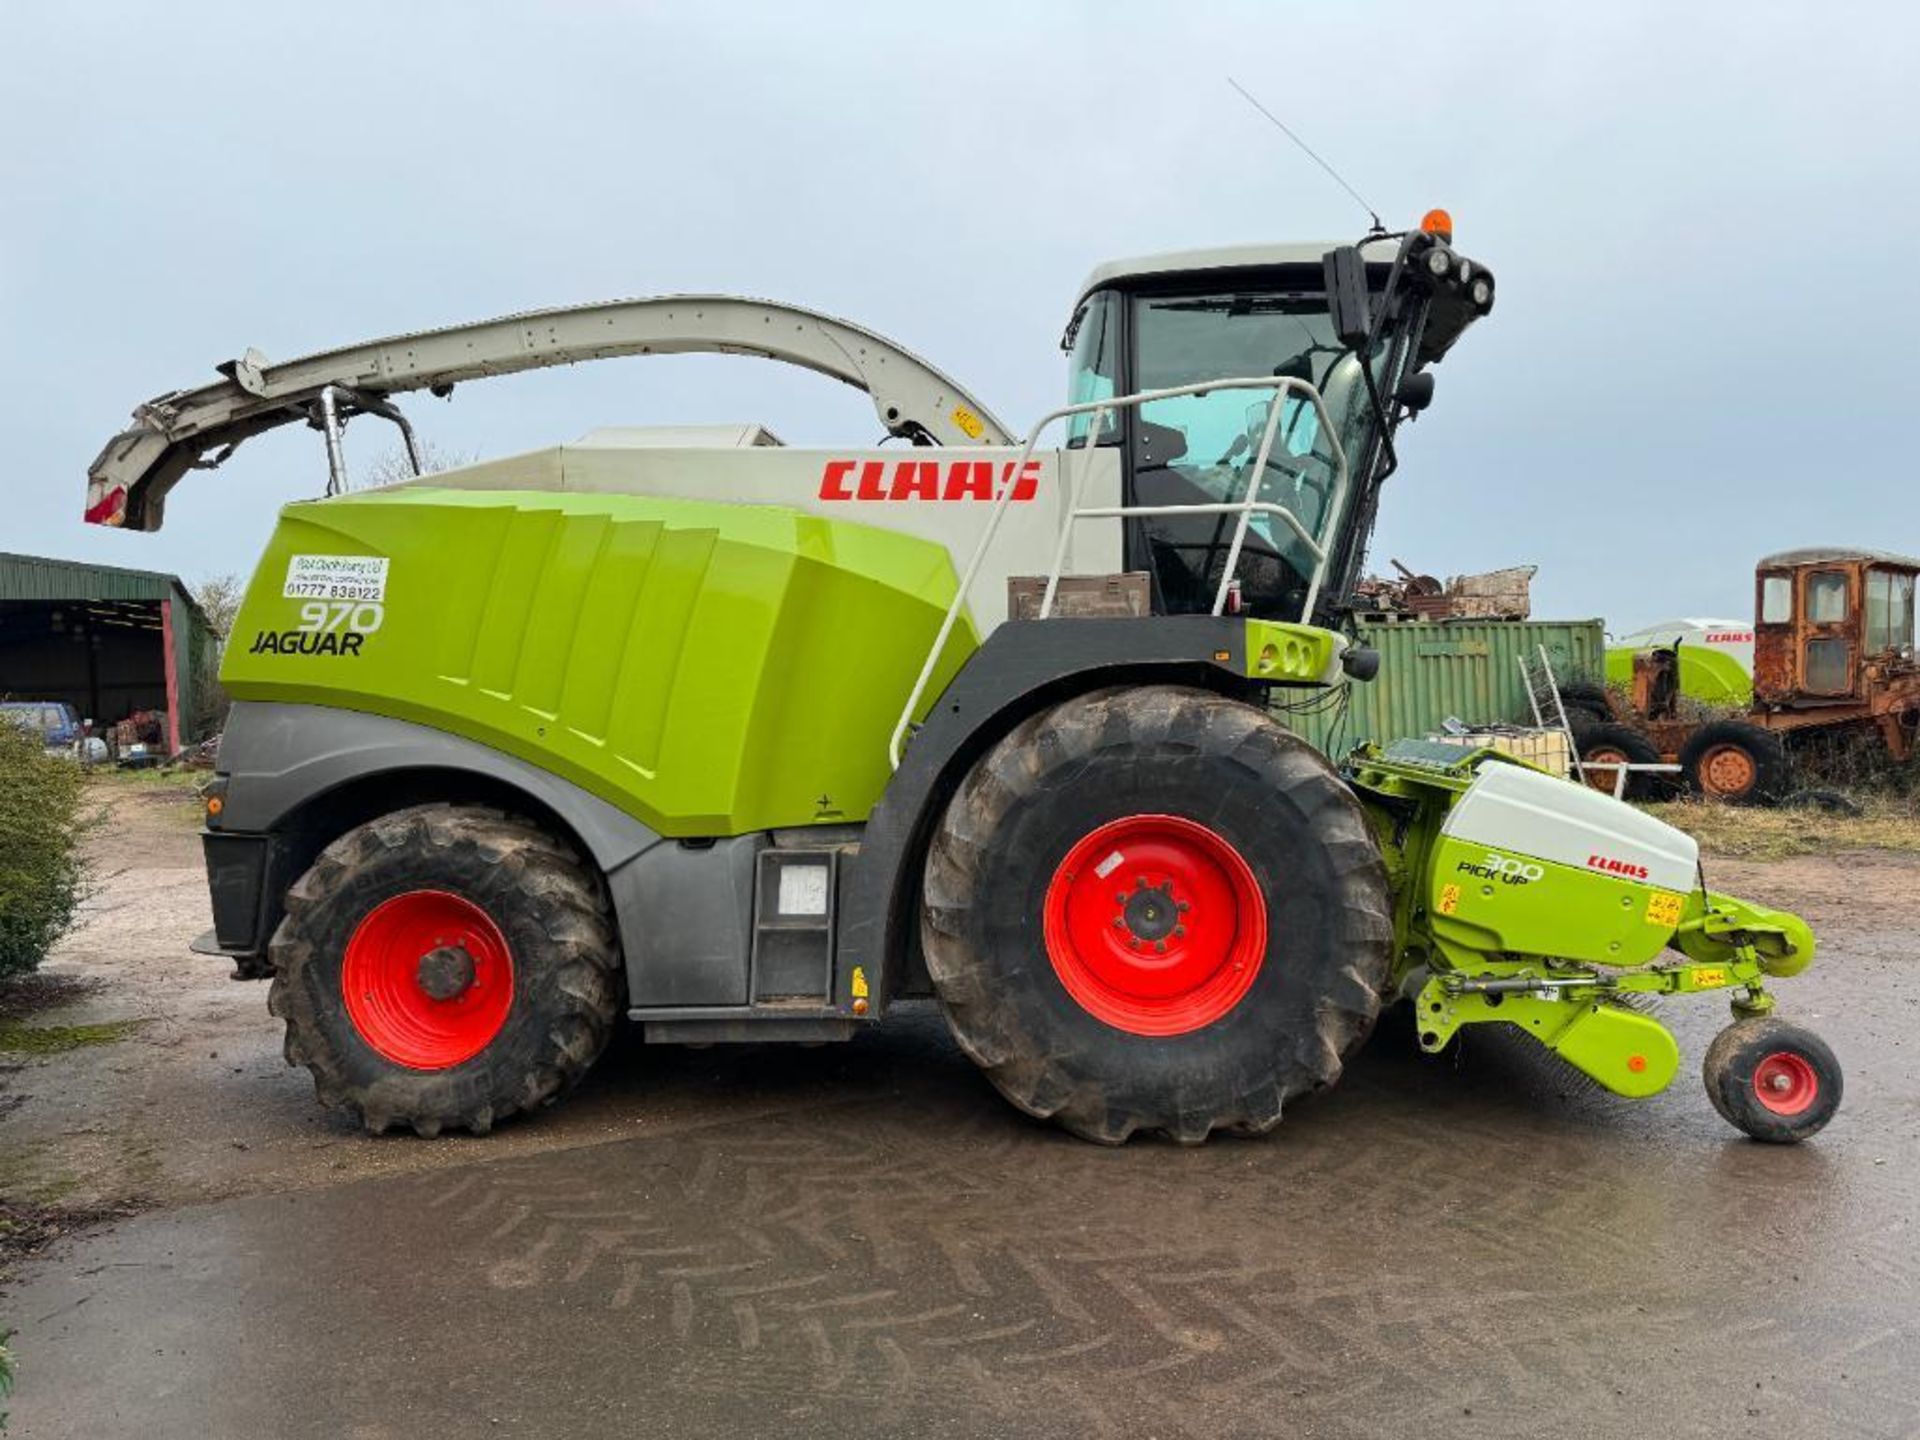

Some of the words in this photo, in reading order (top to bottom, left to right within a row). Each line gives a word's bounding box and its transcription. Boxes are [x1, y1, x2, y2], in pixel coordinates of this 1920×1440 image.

[819, 461, 1041, 501] CLAAS
[287, 584, 326, 596] 01777
[297, 602, 384, 633] 970
[249, 631, 364, 657] JAGUAR
[1706, 633, 1752, 643] CLAAS
[1457, 861, 1499, 881] PICK
[1502, 873, 1529, 886] UP
[1481, 853, 1544, 882] 300
[1587, 855, 1649, 879] CLAAS
